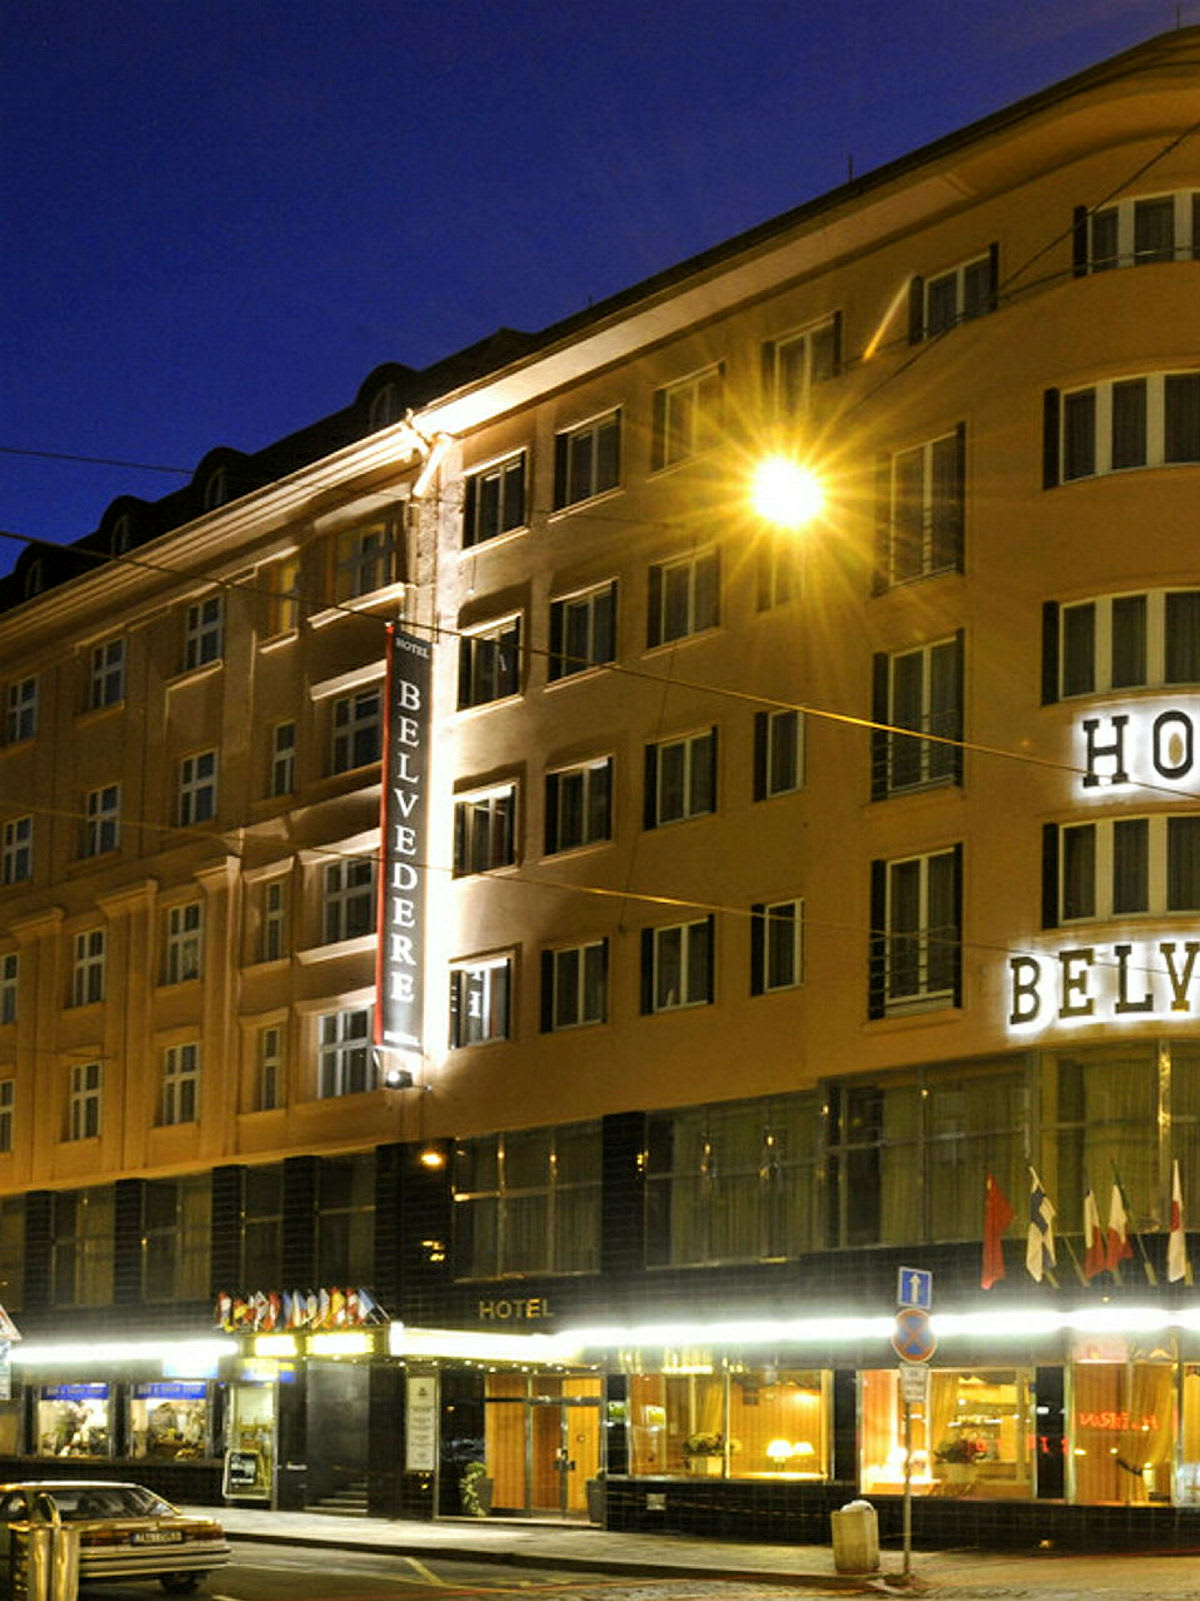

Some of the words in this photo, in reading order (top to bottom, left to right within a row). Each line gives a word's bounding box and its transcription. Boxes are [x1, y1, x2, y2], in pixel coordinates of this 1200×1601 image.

[396, 637, 429, 659] HOTEL
[390, 680, 421, 1003] BELVEDERE
[479, 1298, 554, 1319] HOTEL
